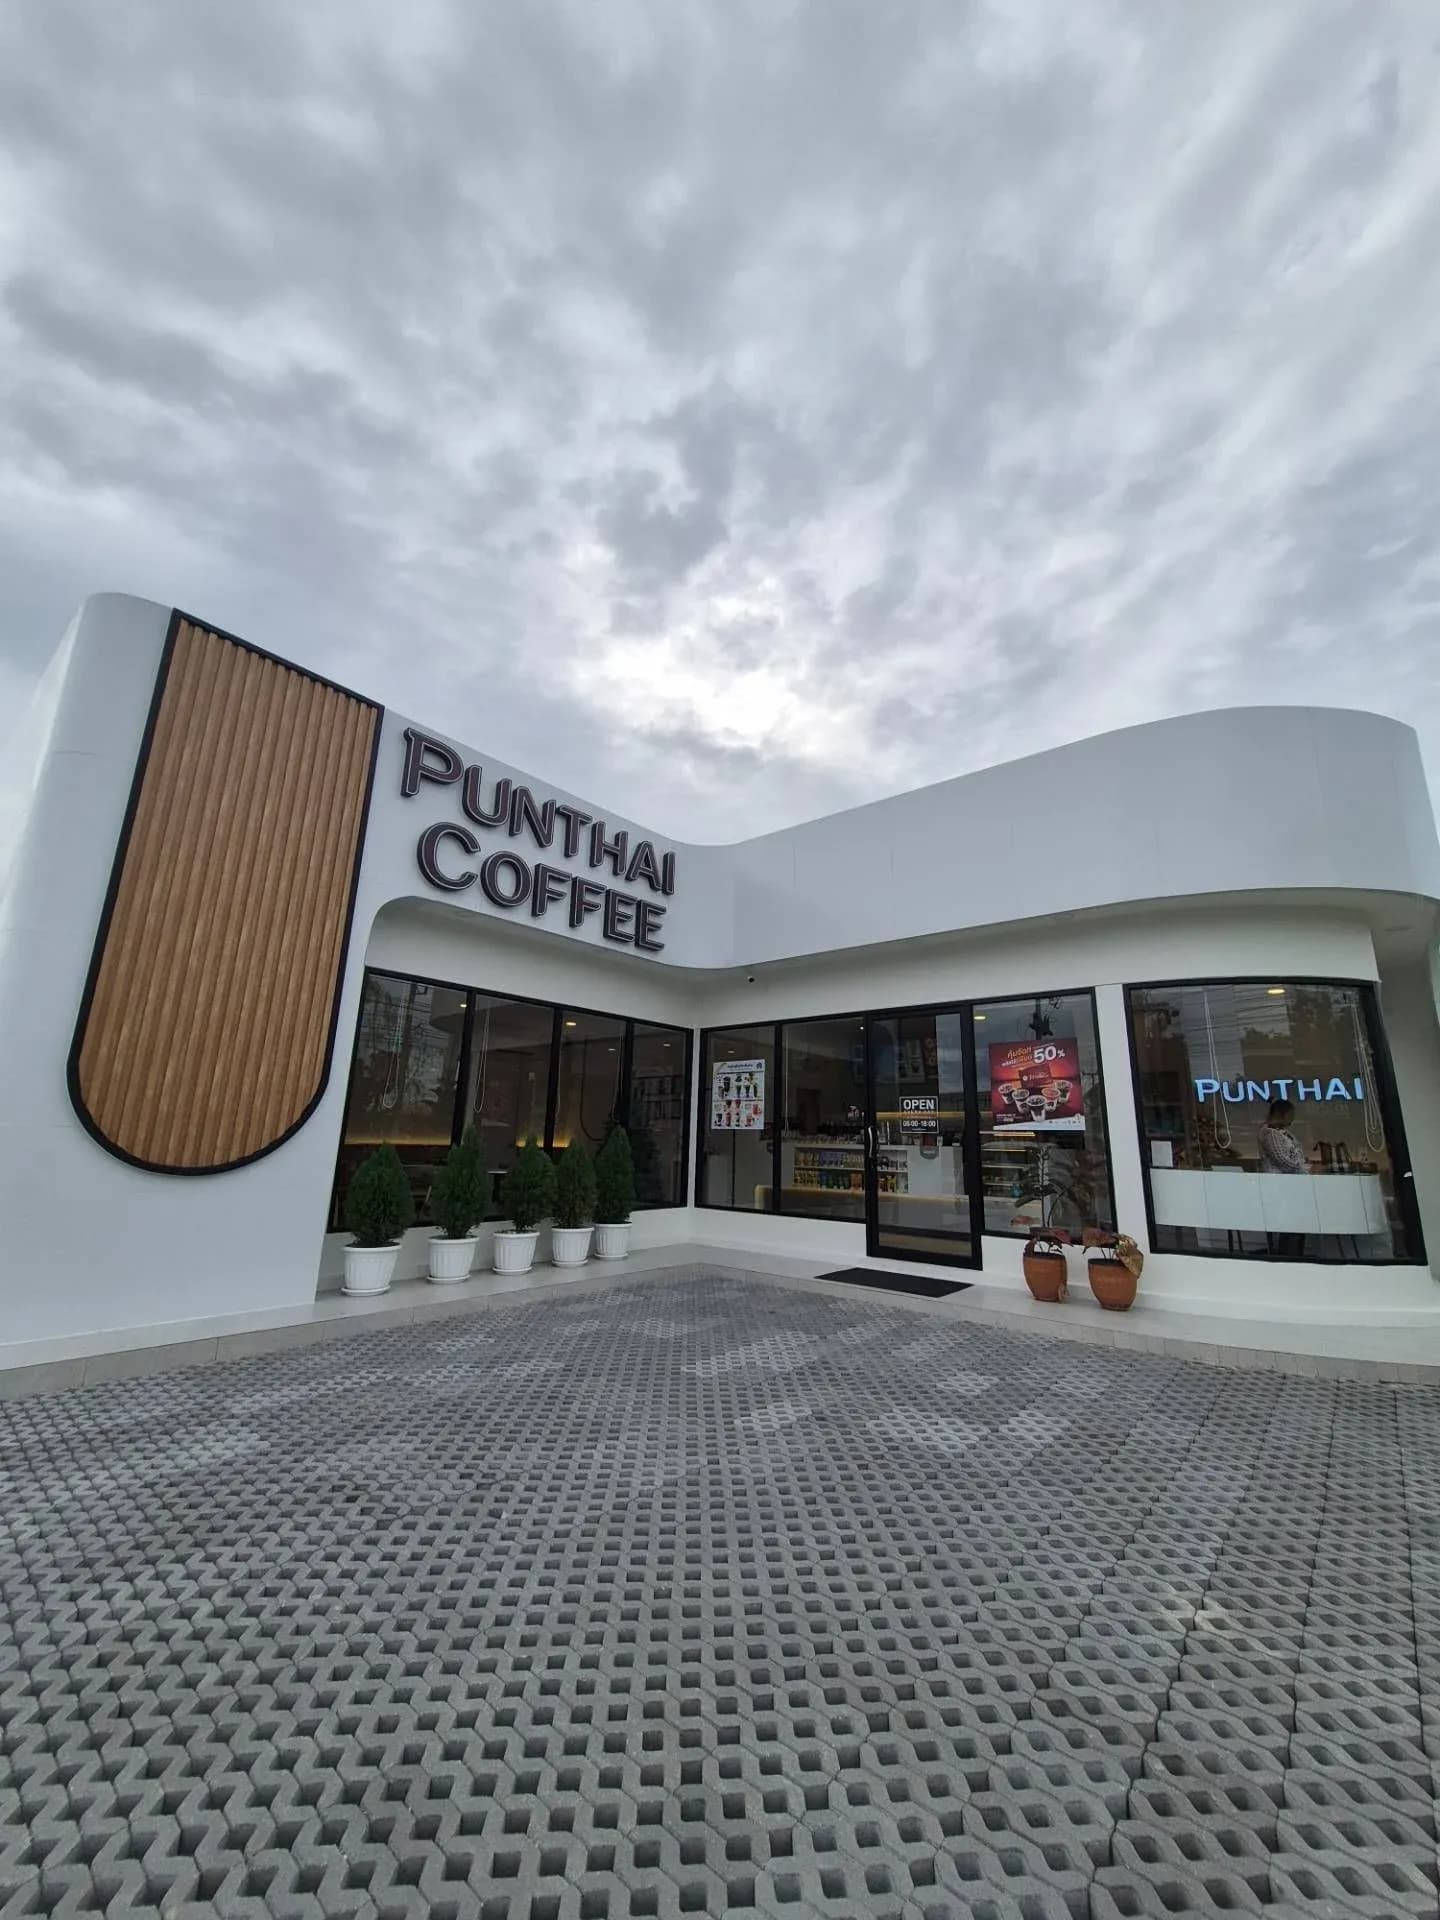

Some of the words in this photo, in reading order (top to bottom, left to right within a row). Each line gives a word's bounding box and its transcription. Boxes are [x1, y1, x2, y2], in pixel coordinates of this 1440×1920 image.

[400, 727, 676, 895] PUNTHAI
[417, 821, 667, 951] COFFEE
[903, 1099, 935, 1110] OPEN
[1194, 1077, 1364, 1103] PUNTHAI
